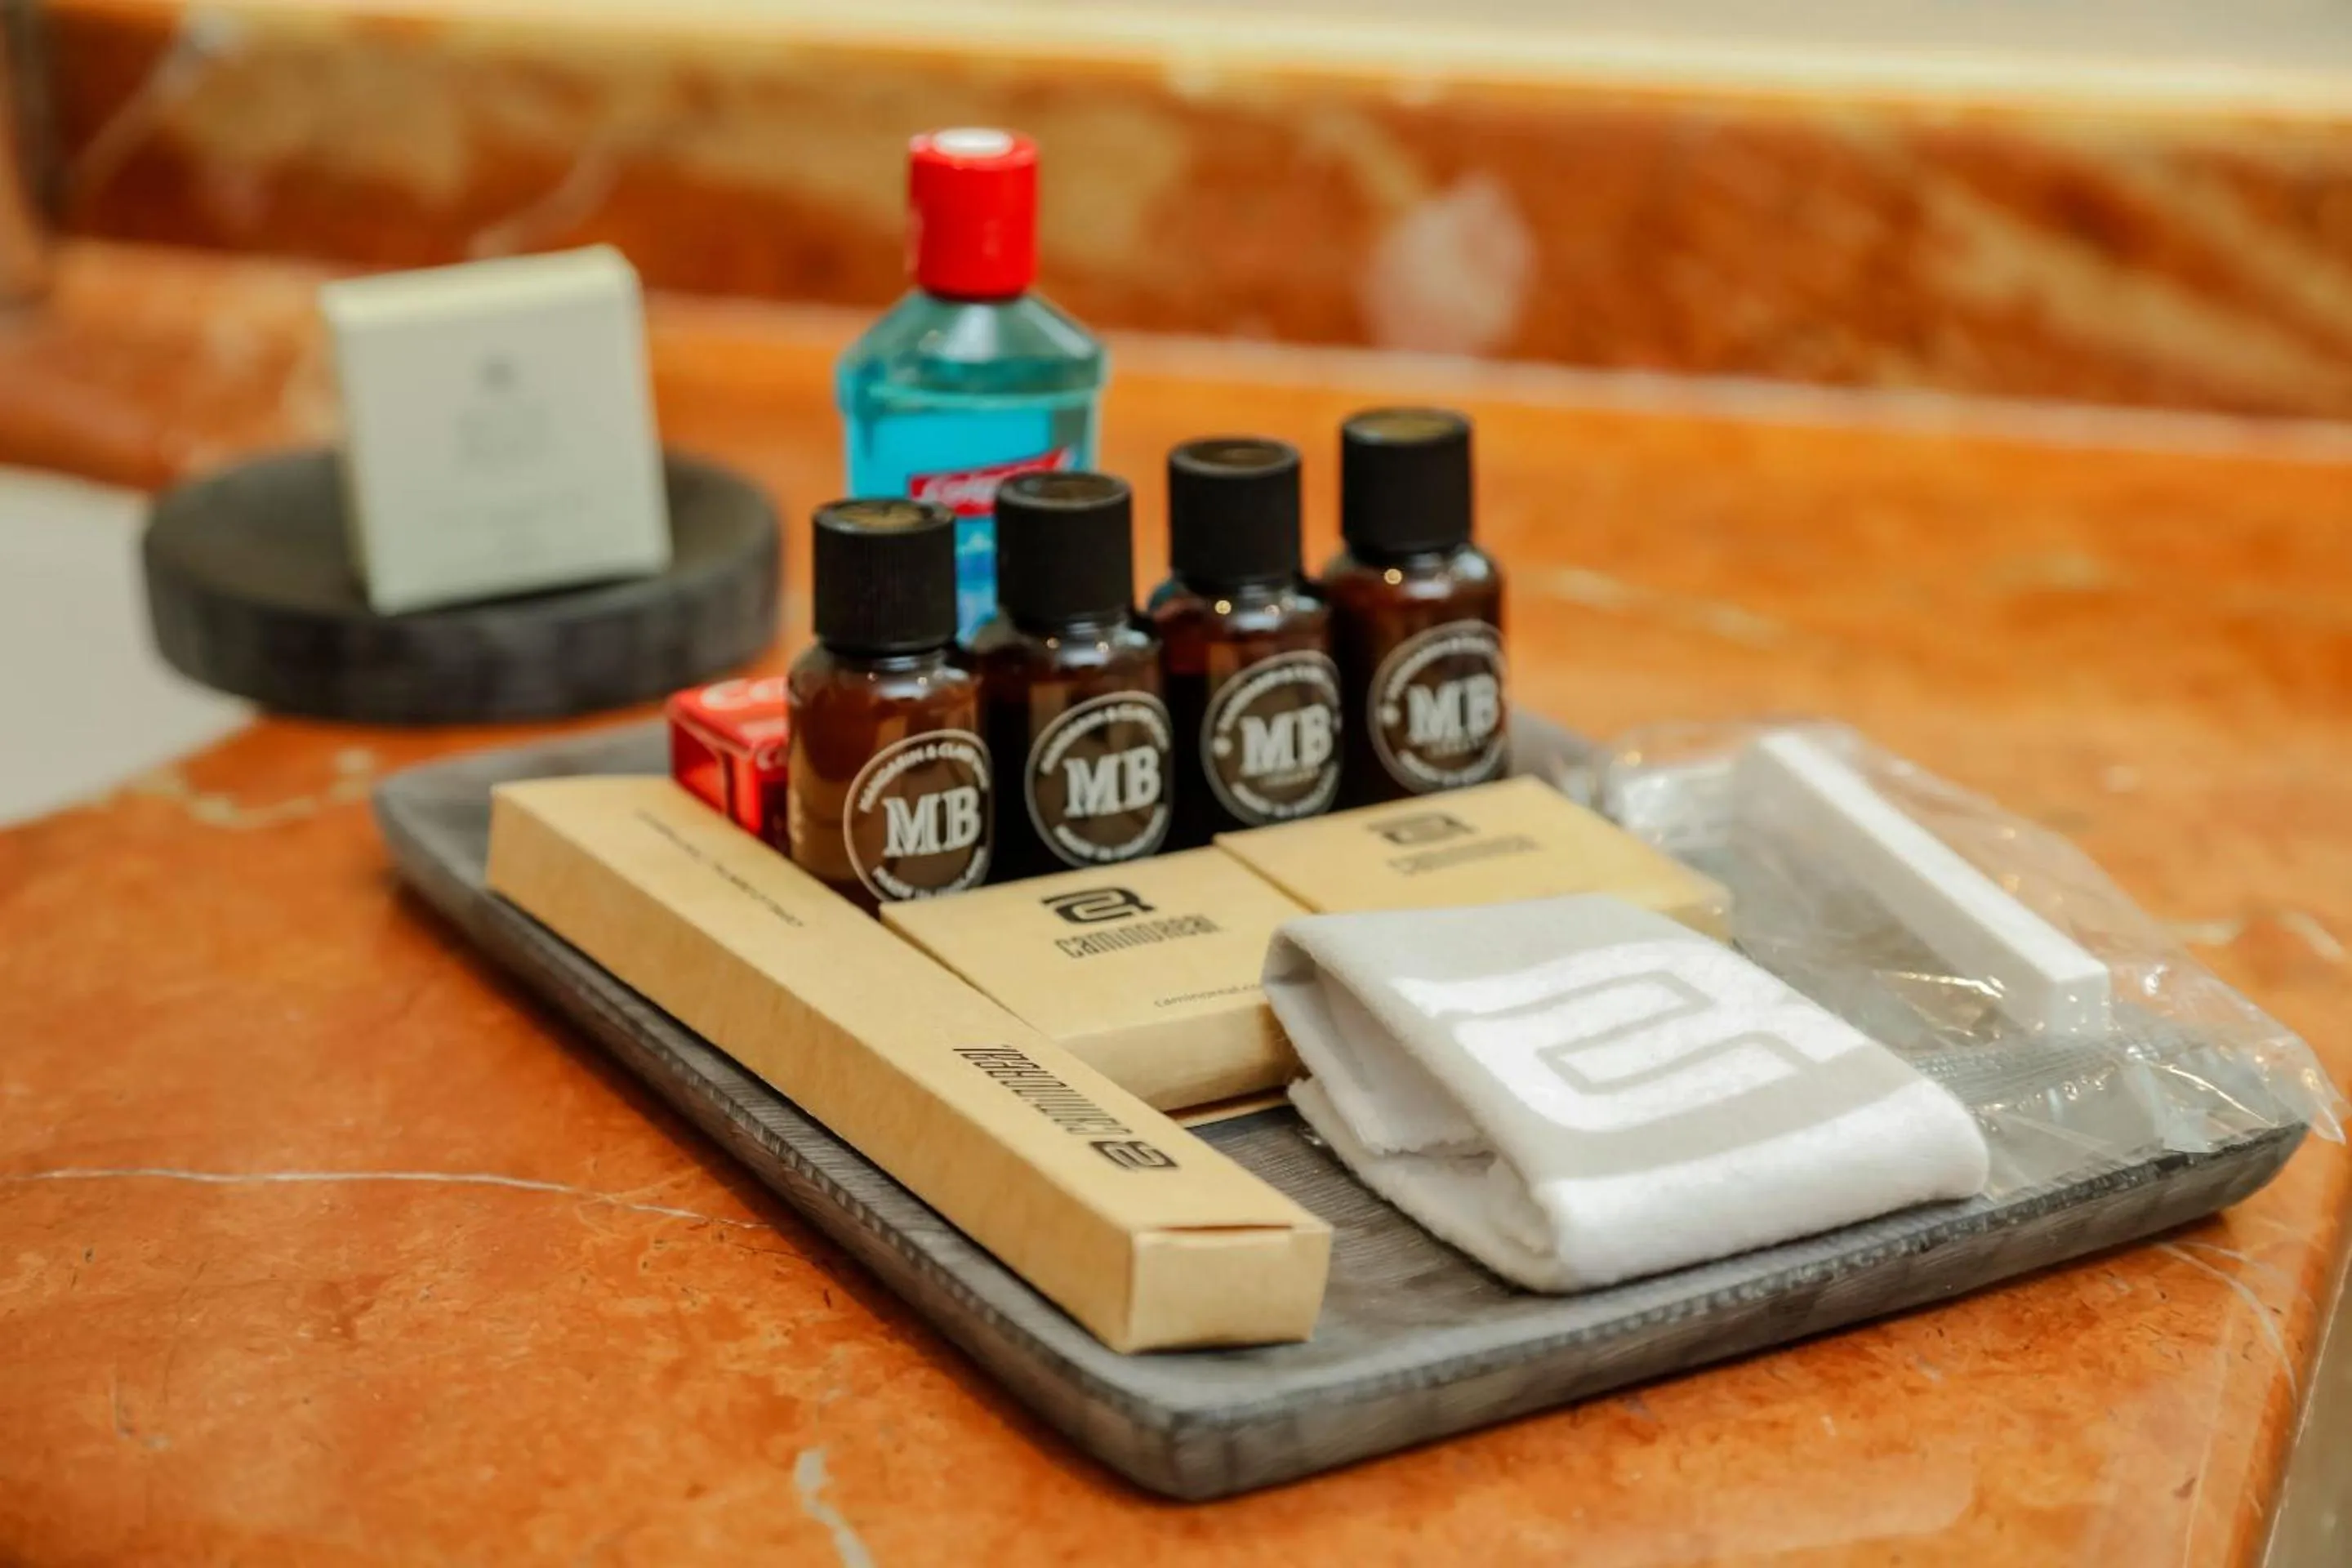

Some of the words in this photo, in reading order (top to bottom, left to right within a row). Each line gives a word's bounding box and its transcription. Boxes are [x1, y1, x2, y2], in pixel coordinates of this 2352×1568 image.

[1239, 703, 1334, 777] MB
[1408, 672, 1499, 746] MB
[1062, 745, 1162, 817] MB
[882, 786, 982, 858] MB
